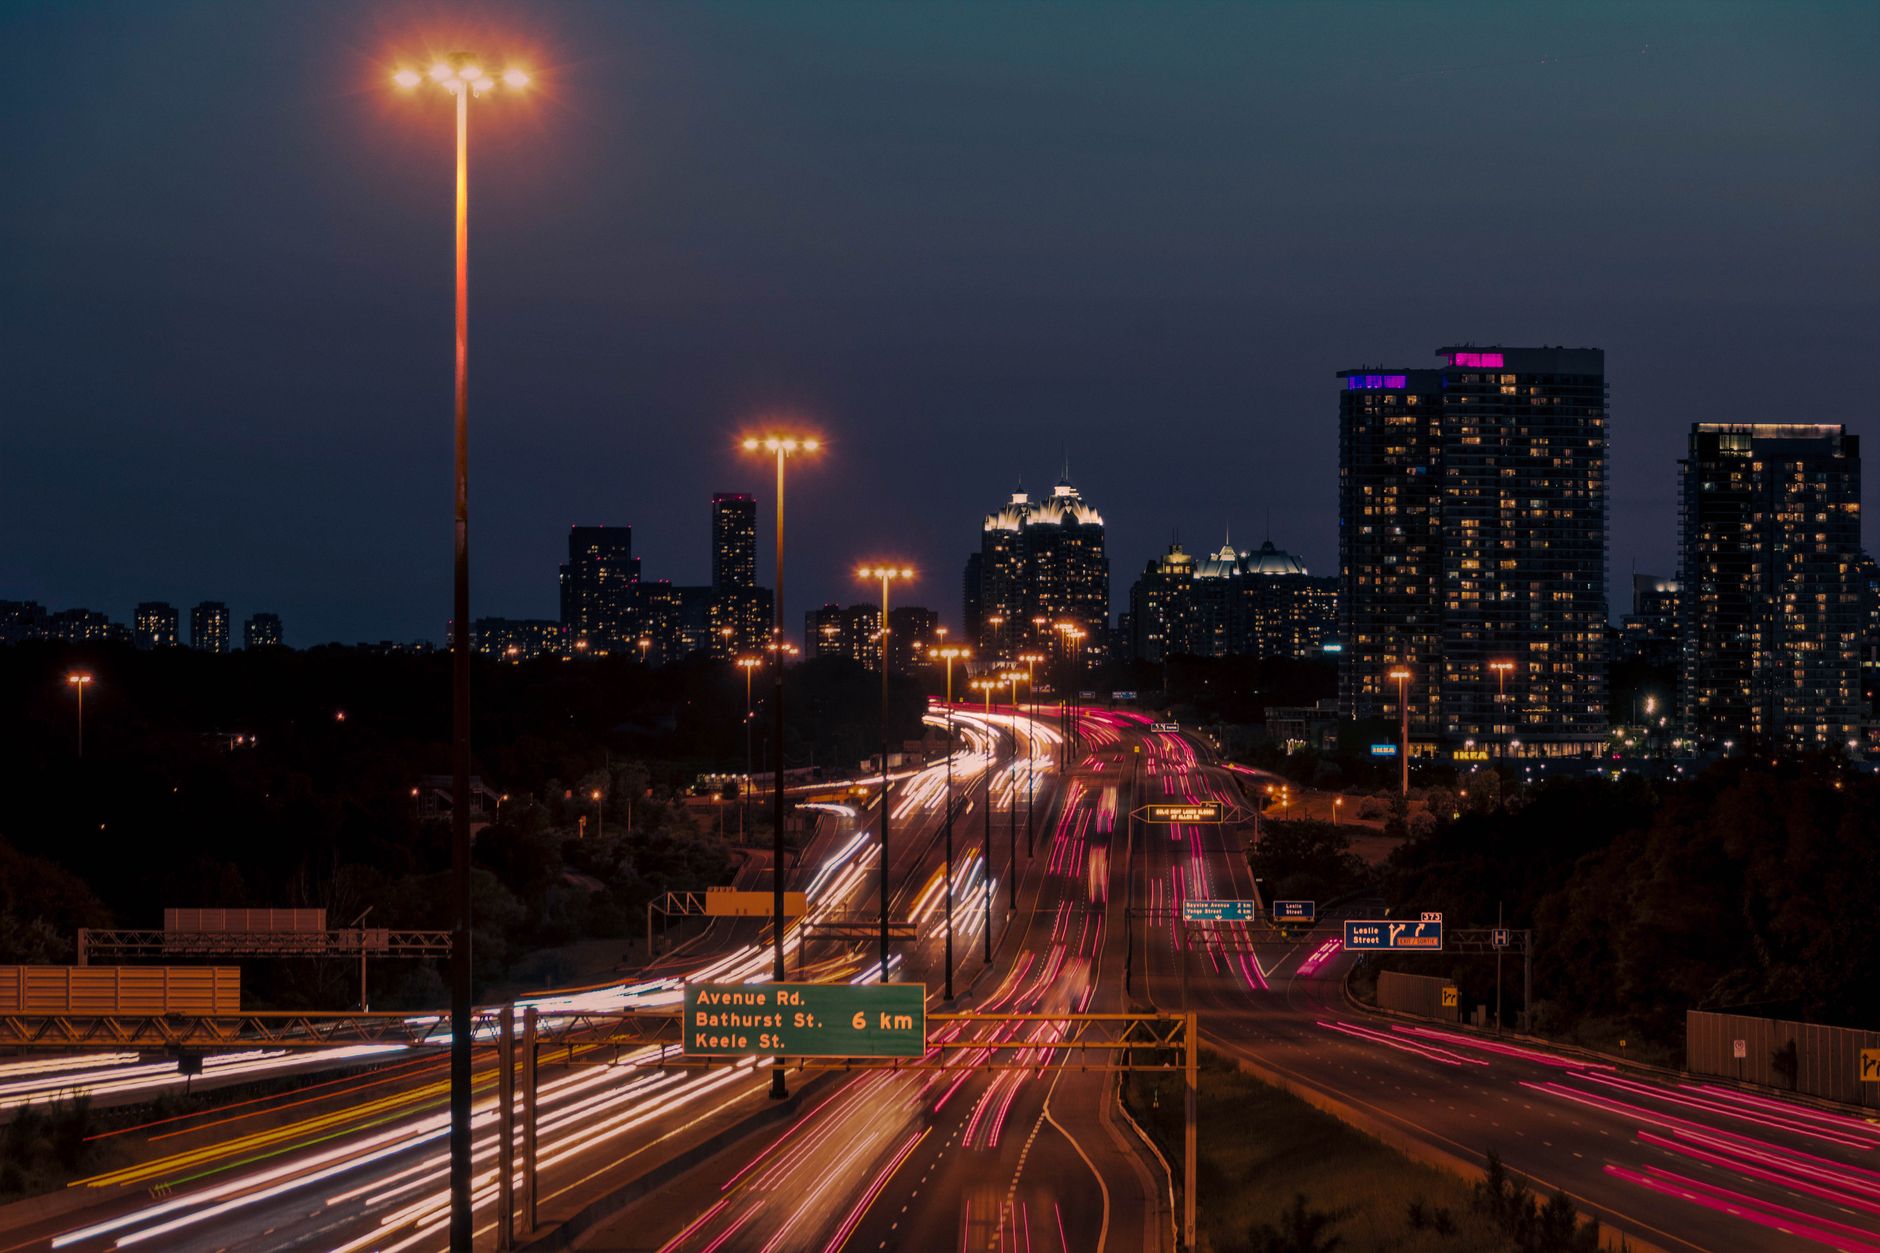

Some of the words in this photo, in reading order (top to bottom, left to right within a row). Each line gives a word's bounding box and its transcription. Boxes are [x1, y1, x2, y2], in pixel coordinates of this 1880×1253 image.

[1453, 751, 1489, 760] IKEA
[1422, 913, 1440, 921] 373
[1353, 926, 1379, 935] Leslie
[1353, 936, 1380, 944] Street
[1495, 930, 1506, 945] H
[696, 990, 767, 1006] Avenue
[776, 990, 806, 1006] Rd.
[695, 1012, 783, 1028] Bathurst
[793, 1012, 824, 1028] St.
[851, 1011, 867, 1030] 6
[880, 1011, 914, 1030] km
[695, 1033, 748, 1049] Keele
[758, 1033, 786, 1049] St.
